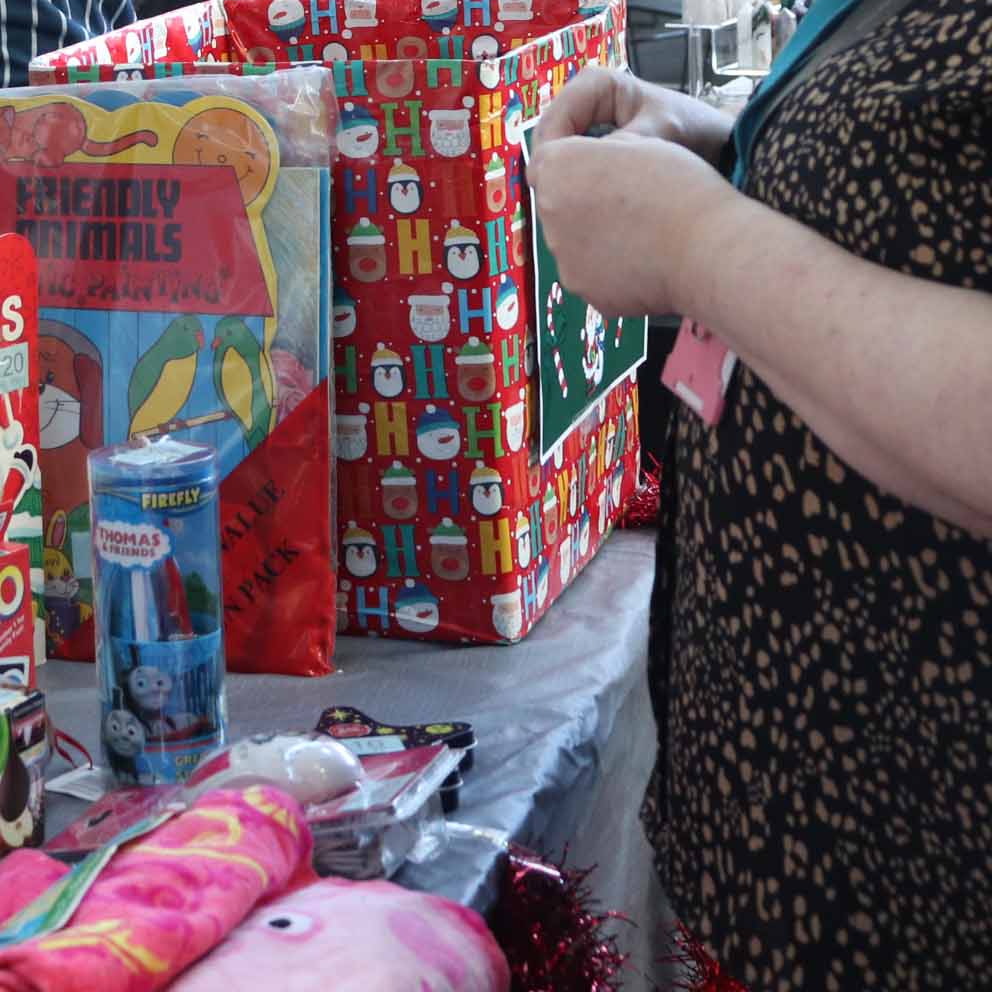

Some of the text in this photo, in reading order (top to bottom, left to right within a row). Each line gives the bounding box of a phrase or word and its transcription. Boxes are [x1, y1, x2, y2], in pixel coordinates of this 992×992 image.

[15, 175, 182, 219] FRIENDLY
[142, 487, 201, 510] FIREFLY
[222, 479, 286, 551] ALUE
[99, 527, 161, 547] THOMAS
[109, 544, 156, 558] FRIENDS
[237, 537, 301, 604] PACK
